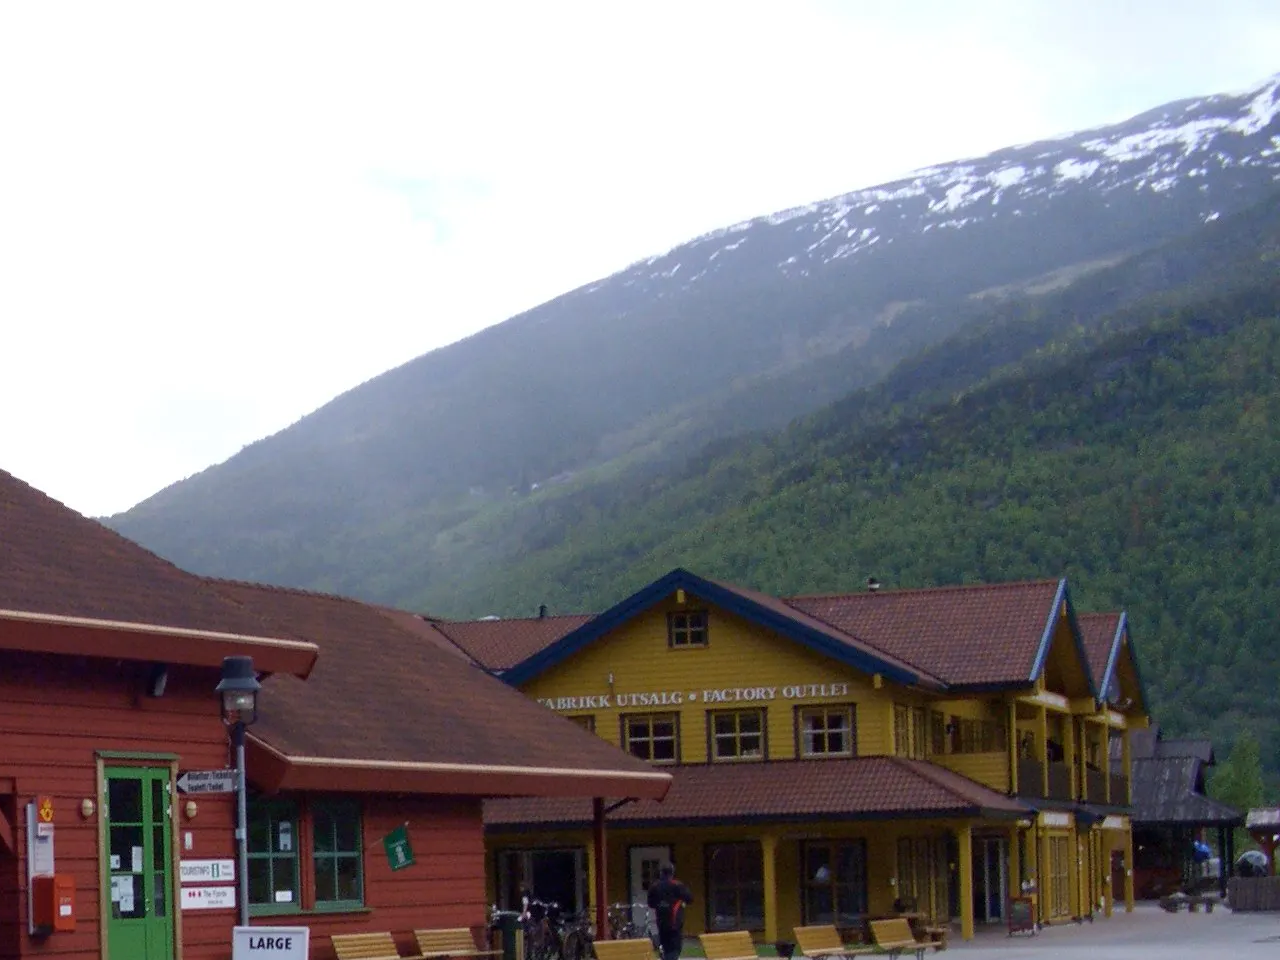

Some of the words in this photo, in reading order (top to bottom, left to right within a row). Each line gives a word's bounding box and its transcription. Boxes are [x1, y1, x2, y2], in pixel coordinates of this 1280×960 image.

[616, 691, 683, 707] UTSALG
[703, 686, 777, 702] FACTORY
[782, 682, 850, 698] OUTLET
[249, 937, 293, 950] LARGE
